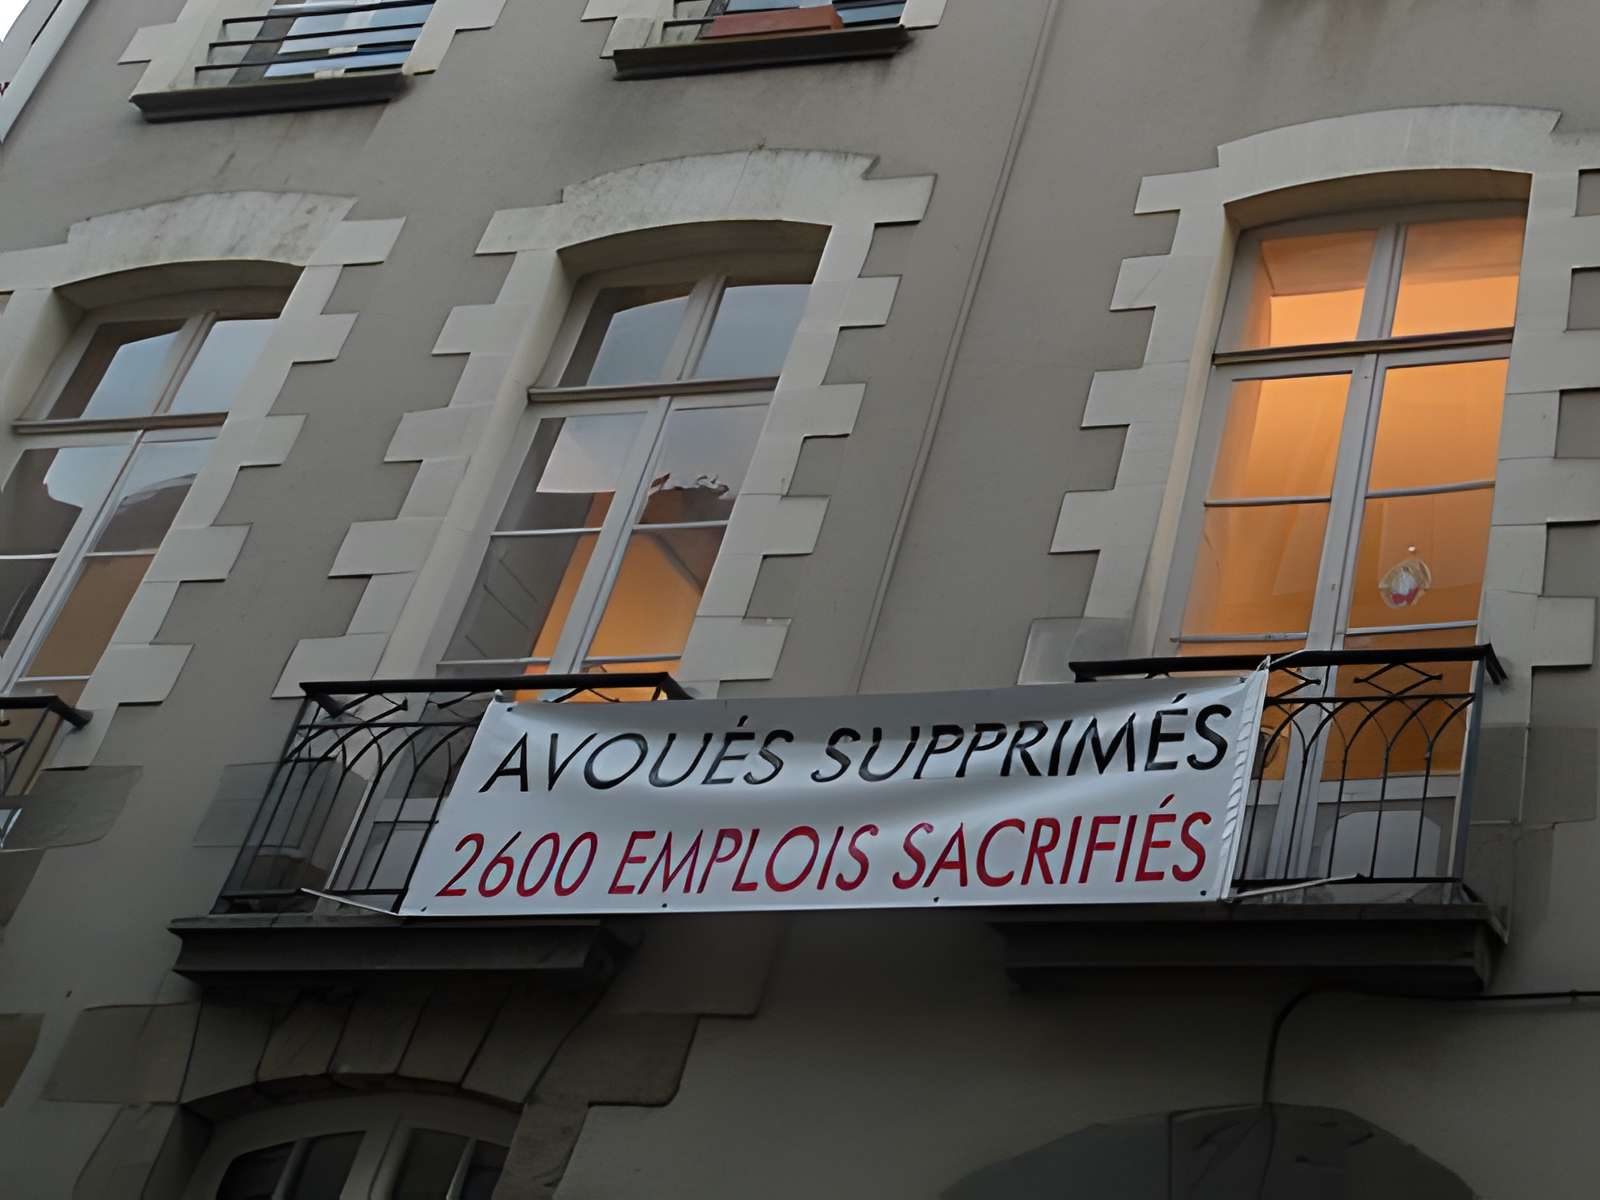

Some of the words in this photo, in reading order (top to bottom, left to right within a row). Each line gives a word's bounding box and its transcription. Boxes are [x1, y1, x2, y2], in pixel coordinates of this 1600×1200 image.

[480, 714, 795, 793] AVOUÉS
[810, 693, 1233, 783] SUPPRIMÉS
[436, 830, 599, 898] 2600
[607, 822, 880, 895] EMPLOIS
[891, 794, 1214, 889] SACRIFIÉS
